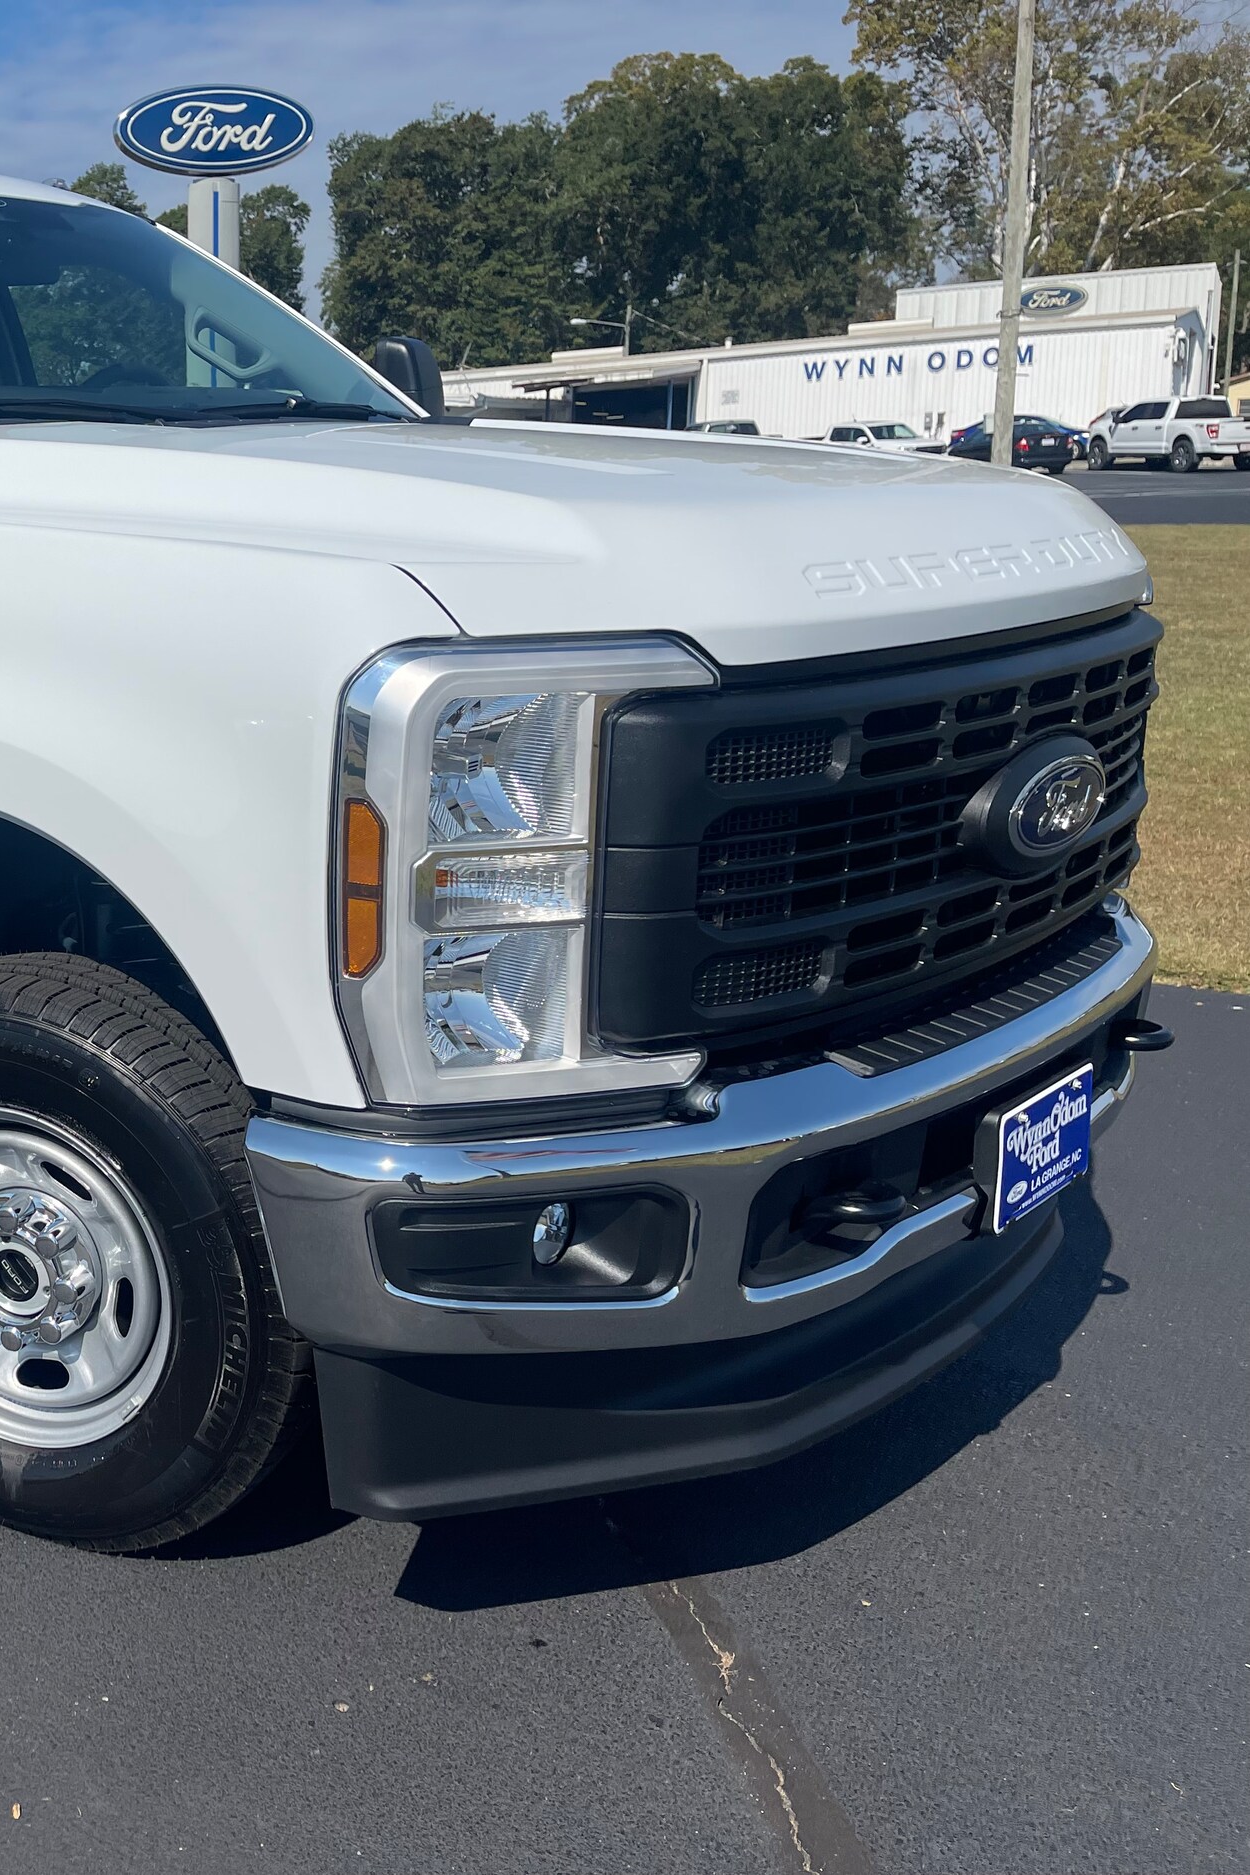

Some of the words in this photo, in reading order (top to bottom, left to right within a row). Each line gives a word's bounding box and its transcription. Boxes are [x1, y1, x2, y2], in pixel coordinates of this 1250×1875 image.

[160, 101, 276, 152] Ford
[1028, 290, 1071, 309] Ford
[804, 355, 903, 381] WYNN
[927, 344, 1034, 372] ODOM
[802, 543, 1040, 599] SUPER
[1027, 1129, 1060, 1174] Ford
[1031, 1175, 1041, 1192] LA
[1, 1259, 29, 1294] FORD
[203, 1273, 248, 1446] MICHELIN
